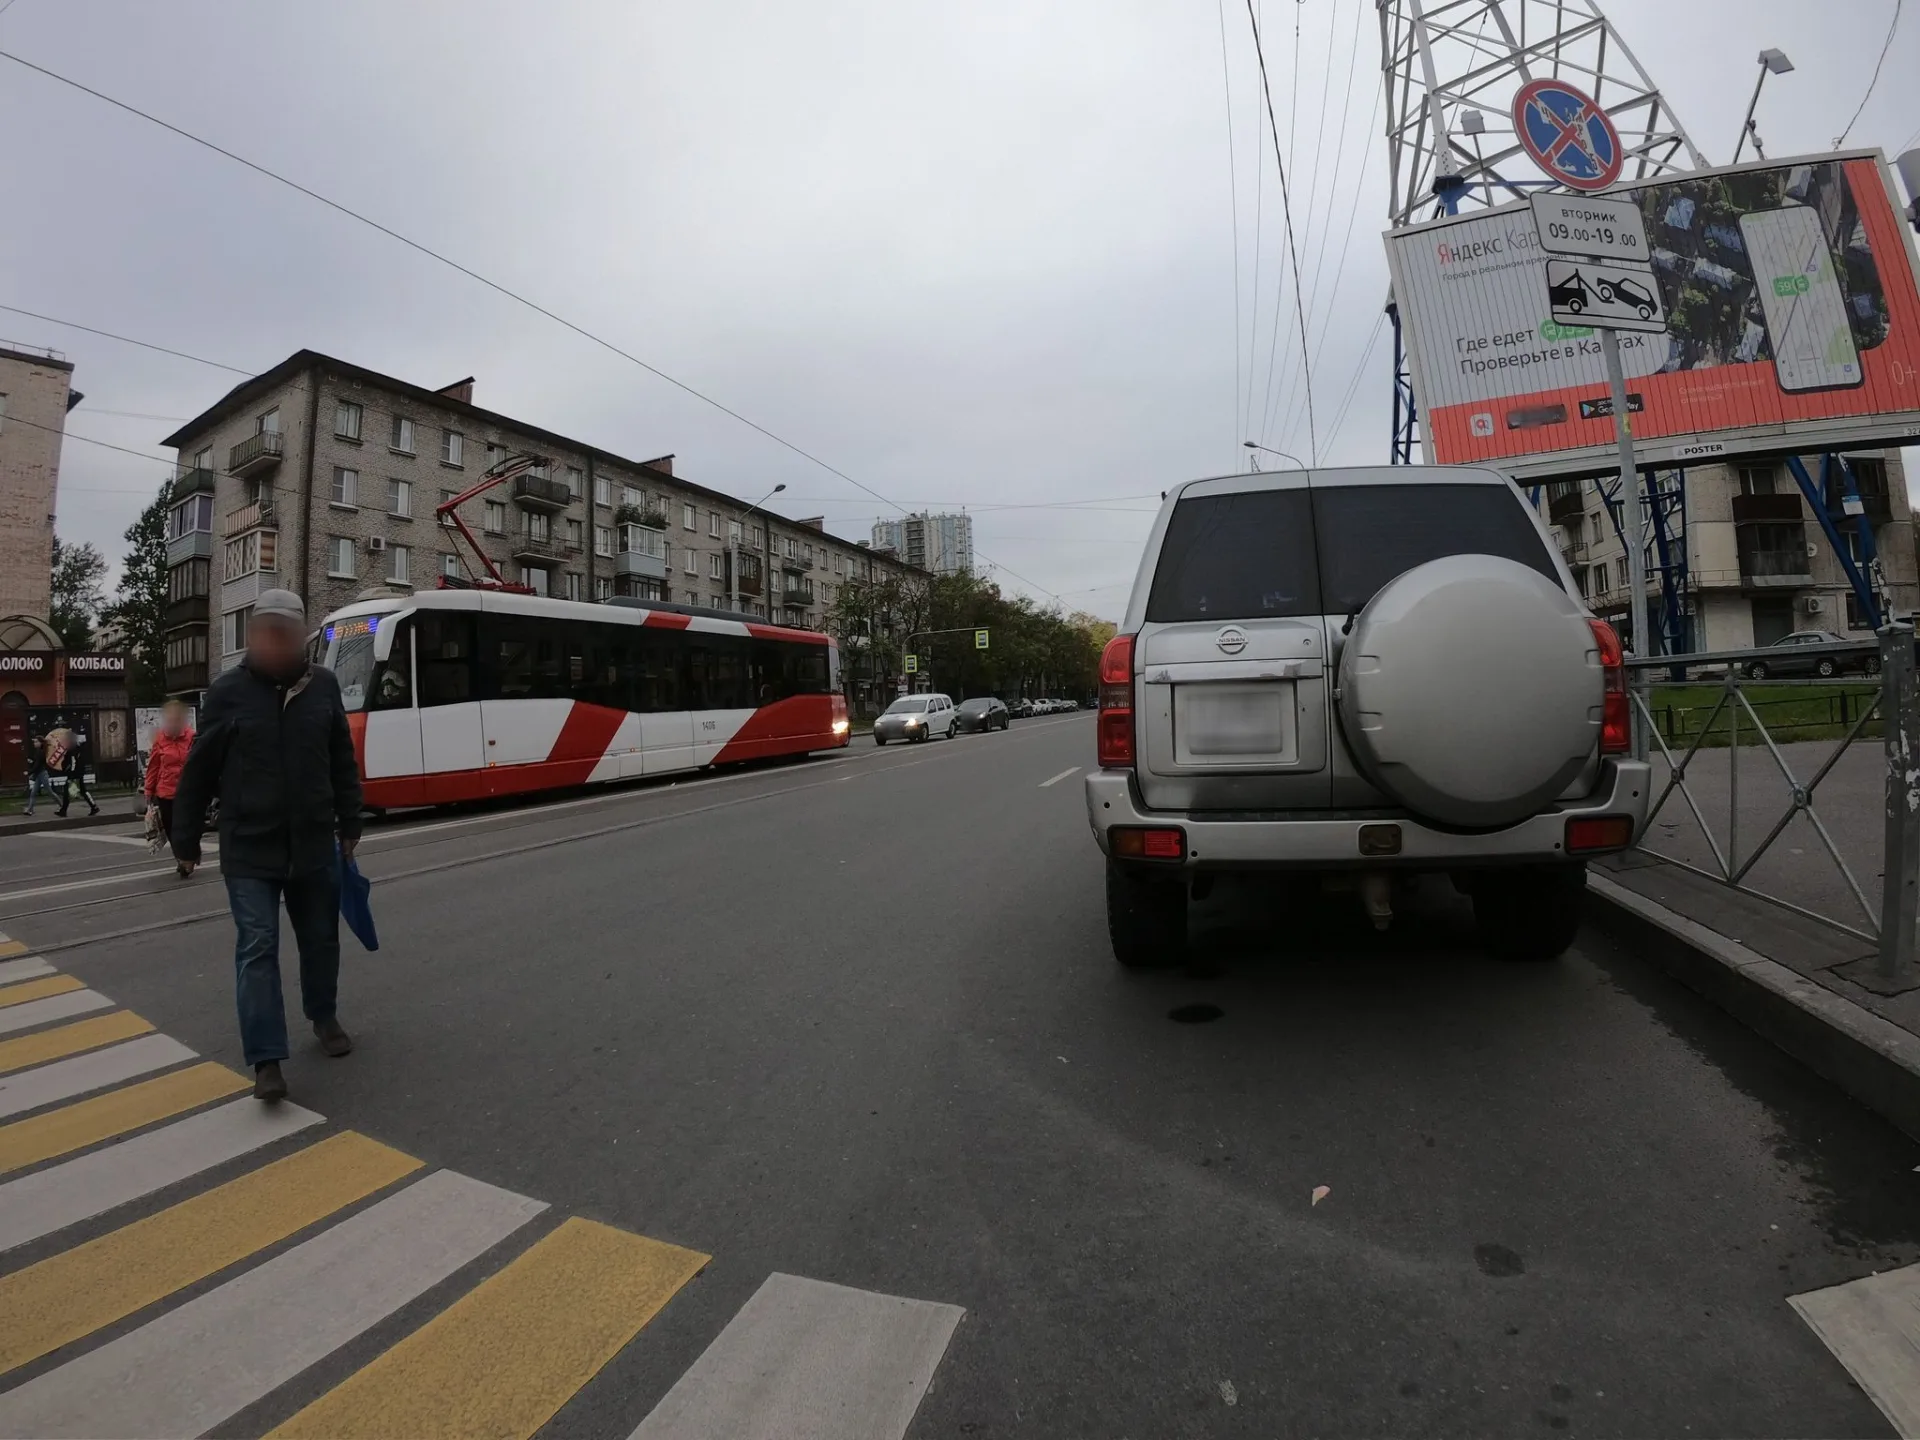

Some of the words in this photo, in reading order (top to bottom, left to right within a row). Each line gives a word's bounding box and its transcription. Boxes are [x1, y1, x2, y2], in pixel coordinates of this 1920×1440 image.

[1561, 209, 1617, 223] вторник
[1437, 238, 1503, 265] Яндекс
[1505, 228, 1541, 252] Кар
[1442, 269, 1471, 281] Город
[1480, 260, 1524, 275] реальном
[1456, 337, 1488, 353] Где
[1493, 328, 1535, 347] едет
[1460, 347, 1561, 376] Проверьте
[1565, 346, 1575, 358] в
[1578, 335, 1645, 356] Катах
[1891, 361, 1917, 385] 0+
[1684, 444, 1723, 455] POSTER
[0, 657, 43, 670] ОЛОКО
[69, 657, 124, 670] КОЛБАСЫ
